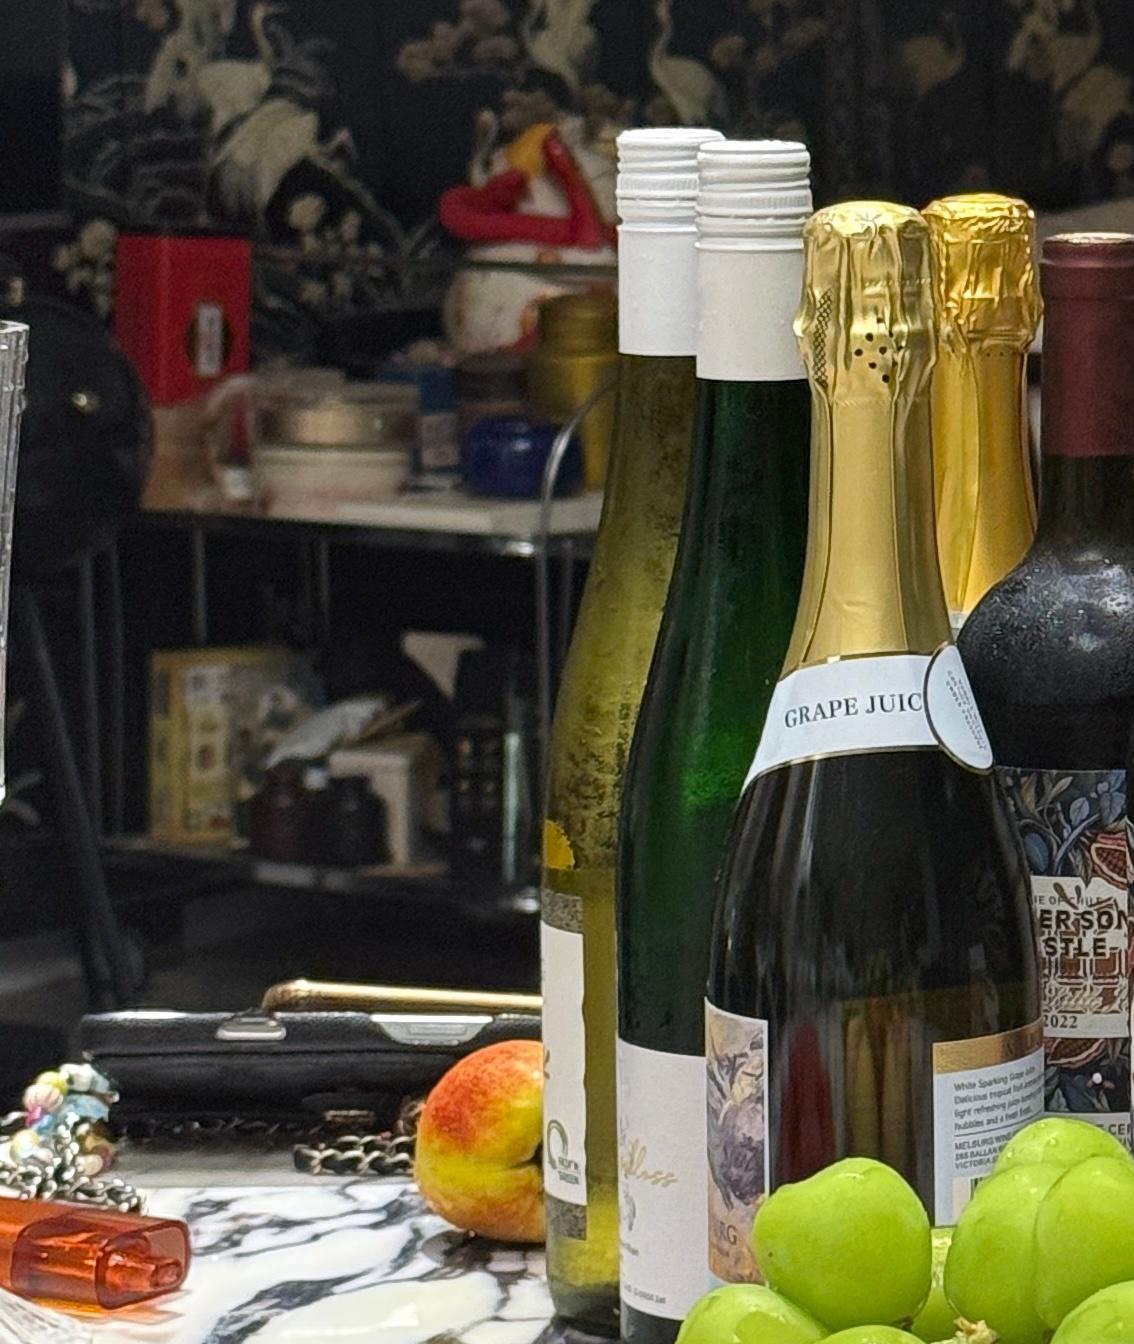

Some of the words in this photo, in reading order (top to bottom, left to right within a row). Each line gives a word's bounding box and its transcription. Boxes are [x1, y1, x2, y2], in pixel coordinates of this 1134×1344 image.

[784, 697, 859, 729] GRAPE
[1043, 1014, 1078, 1028] 2022
[953, 1082, 977, 1092] White
